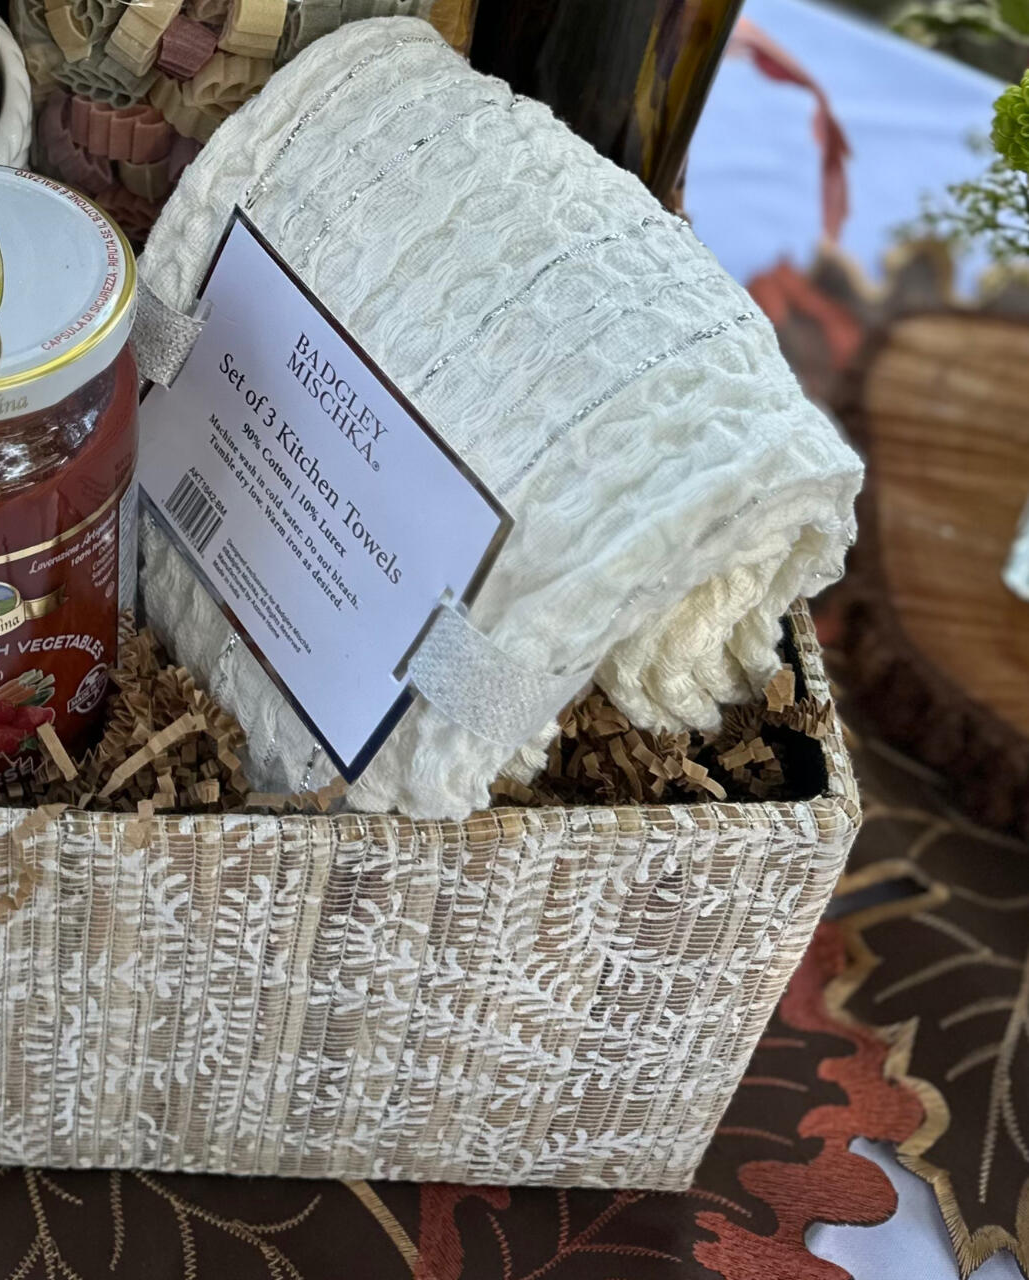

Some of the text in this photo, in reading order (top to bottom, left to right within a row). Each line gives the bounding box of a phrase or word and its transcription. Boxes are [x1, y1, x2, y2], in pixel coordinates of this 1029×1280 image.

[14, 170, 60, 191] RIALZATO
[67, 192, 103, 222] BOTTONE
[98, 221, 106, 229] IL
[101, 228, 113, 240] SE
[106, 239, 118, 267] RIFIUTA
[90, 272, 118, 313] SICUREZZA
[83, 310, 95, 322] DI
[41, 321, 86, 351] CAPSULA
[295, 332, 389, 443] BADGLEY
[219, 353, 403, 585] Set of 3 Kitchen Towels
[242, 423, 261, 450] 90%
[262, 447, 293, 490] Cotton
[298, 494, 319, 522] 10%
[318, 518, 347, 558] Lurex
[208, 413, 359, 610] Machine wash in cold water. Do not bleach.
[208, 434, 343, 612] Tumble dry low. Warm iron as desired.
[17, 634, 104, 661] VEGETABLES
